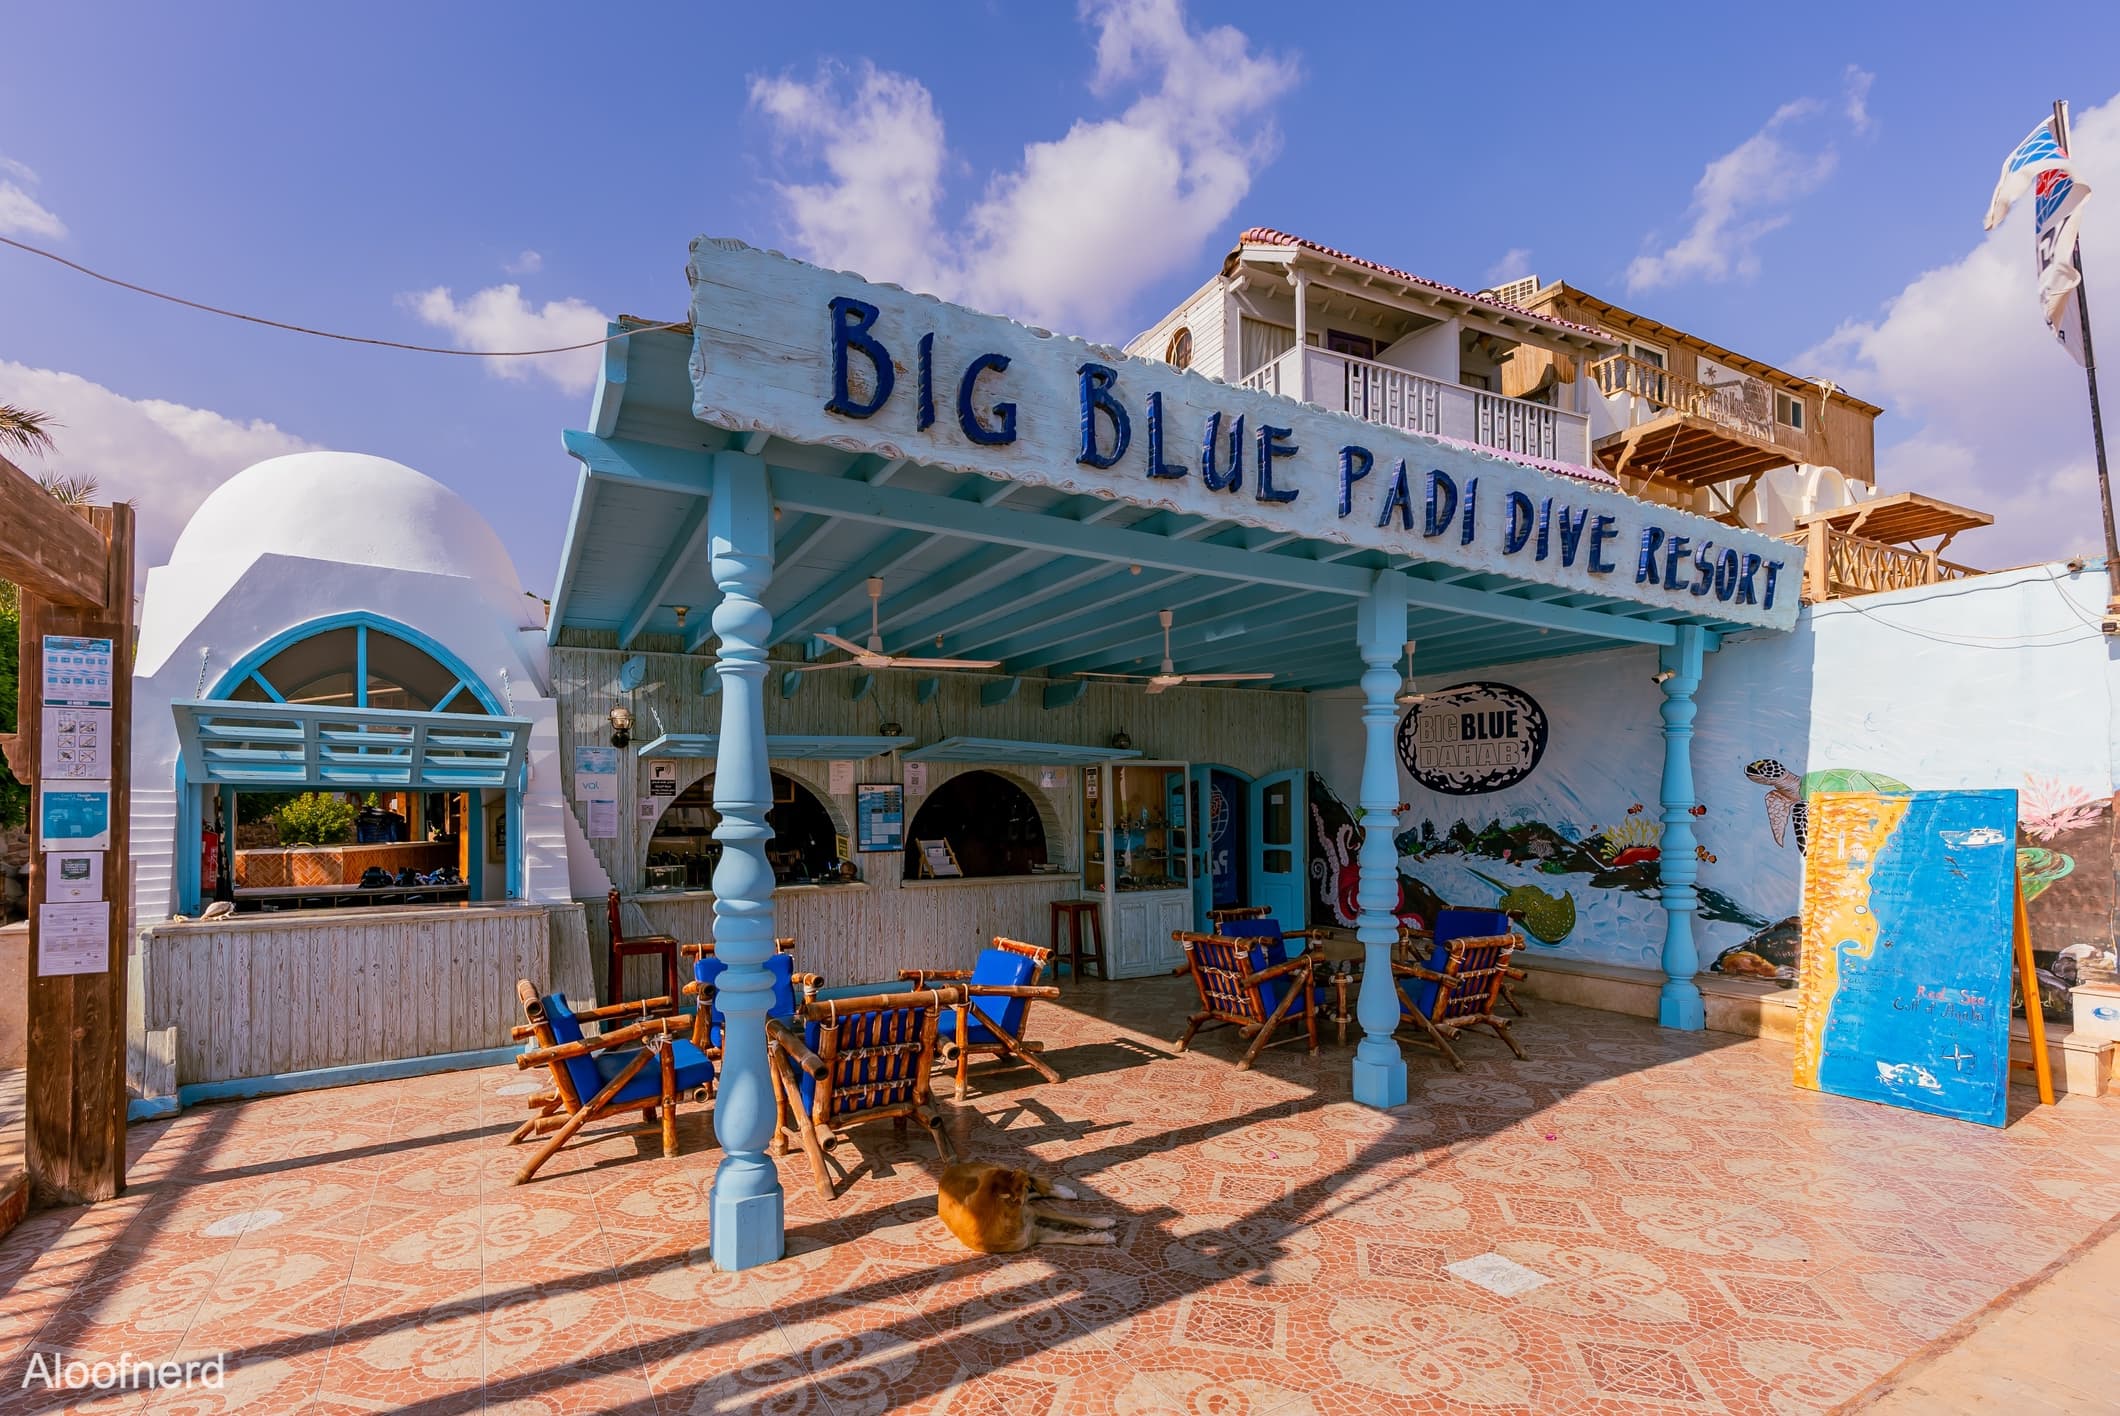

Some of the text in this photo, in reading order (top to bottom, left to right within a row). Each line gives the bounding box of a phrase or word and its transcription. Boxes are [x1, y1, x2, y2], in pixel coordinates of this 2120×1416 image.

[824, 296, 1785, 611] BIG BLUE PADI DIVE RESORT
[1419, 709, 1519, 744] BIG BLUE
[1419, 741, 1521, 769] DAHAB
[1916, 985, 1987, 1007] Red Sea
